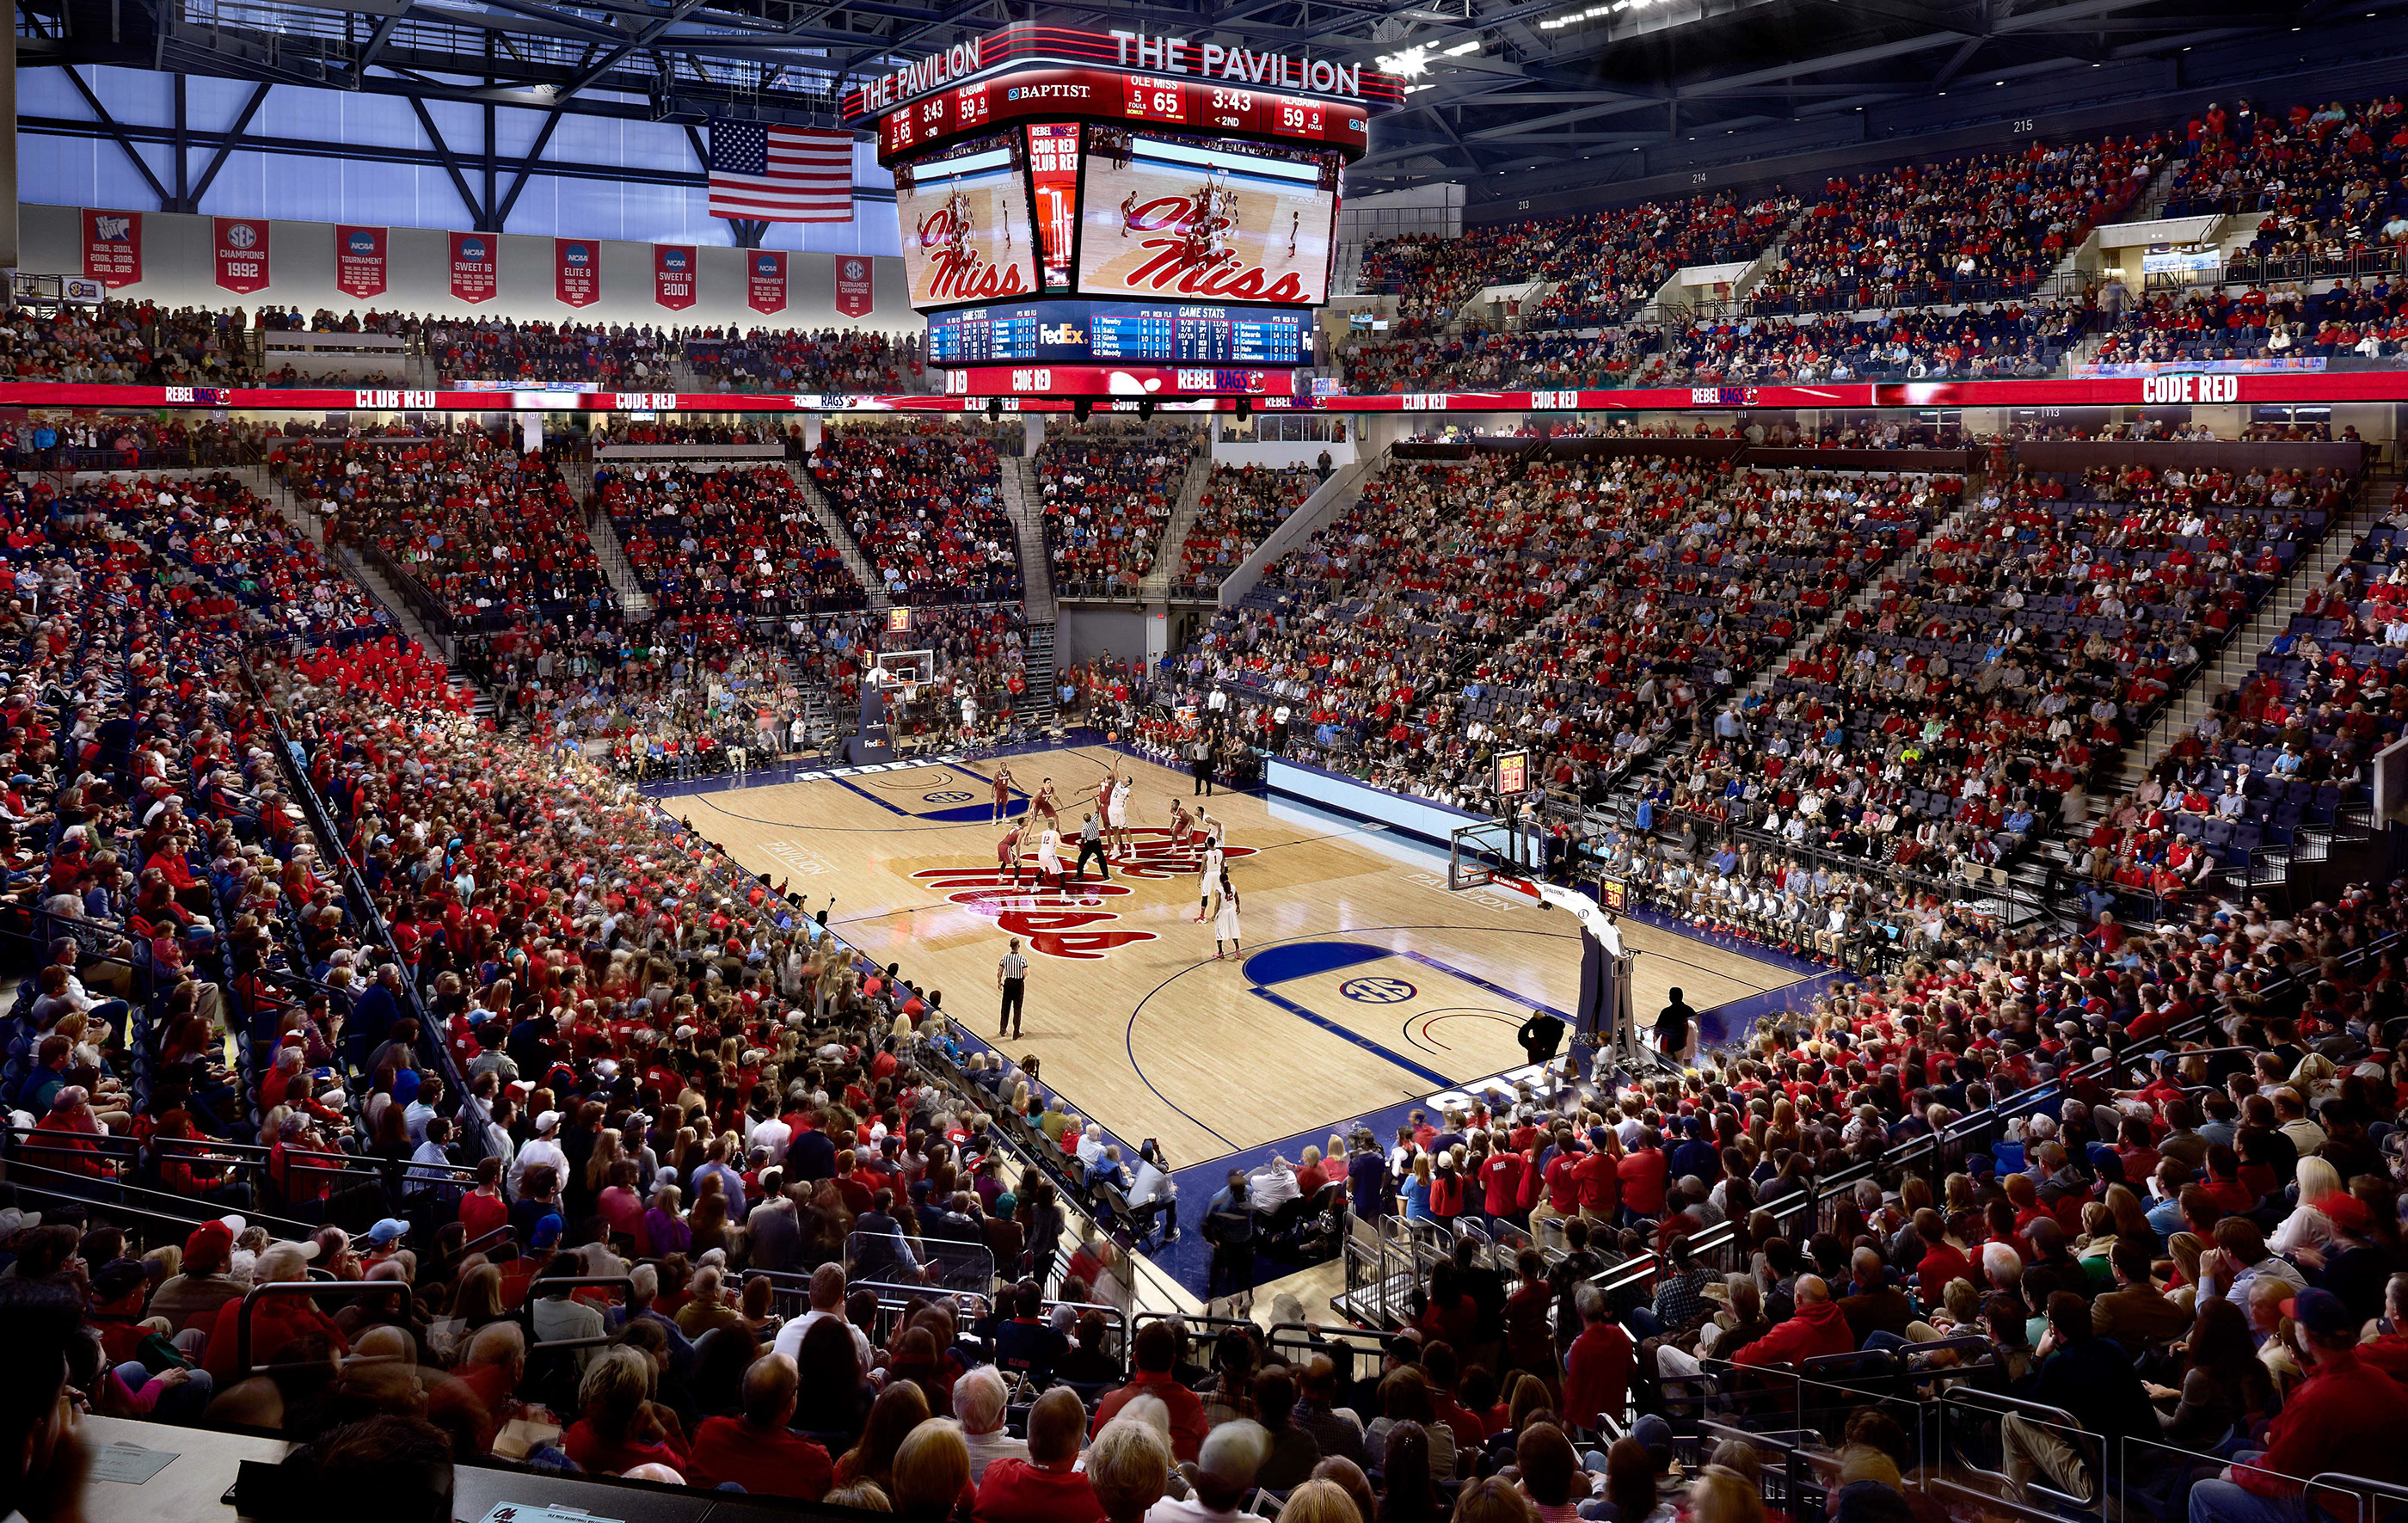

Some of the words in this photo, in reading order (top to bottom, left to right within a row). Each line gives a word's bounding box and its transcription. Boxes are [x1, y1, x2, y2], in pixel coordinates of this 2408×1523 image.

[1109, 29, 1188, 73] THE
[1202, 44, 1361, 96] PAVILION
[860, 73, 894, 113] THE
[897, 36, 982, 101] PAVILION
[959, 82, 986, 99] ALABAMA
[1131, 76, 1151, 88] OLE
[1153, 78, 1178, 90] MISS
[961, 98, 975, 120] 59
[980, 96, 985, 108] 9
[1128, 101, 1146, 110] FOULS
[1133, 90, 1141, 102] 5
[1153, 92, 1178, 113] 65
[1212, 89, 1251, 112] 3:43
[1281, 96, 1320, 109] ALABAMA
[923, 99, 943, 122] 3:43
[1283, 109, 1304, 127] 59
[1312, 113, 1319, 124] 9
[1222, 116, 1239, 127] 2ND
[2013, 119, 2033, 132] 215
[894, 126, 898, 138] 5
[900, 120, 911, 140] 65
[1032, 139, 1056, 154] CODE
[1058, 138, 1076, 153] RED
[1030, 154, 1057, 171] CLUB
[1692, 173, 1706, 183] 214
[1518, 200, 1529, 210] 213
[230, 226, 254, 247] SEC
[219, 249, 265, 260] CHAMPIONS
[341, 255, 383, 264] TOURNAMENT
[114, 265, 132, 273] 2015
[227, 262, 258, 277] 1992
[455, 261, 482, 272] SWEET
[484, 263, 492, 273] 16
[564, 267, 584, 277] ELITE
[586, 268, 591, 277] 8
[846, 261, 863, 279] SEC
[659, 272, 683, 281] SWEET
[685, 273, 692, 282] 16
[751, 276, 783, 285] TOURNAMENT
[664, 283, 688, 297] 2001
[1179, 307, 1201, 317] GAME
[1202, 308, 1225, 319] STATS
[1040, 323, 1084, 344] FedEx
[955, 370, 968, 393] RED
[1012, 369, 1033, 390] CODE
[1034, 369, 1051, 390] RED
[2143, 377, 2193, 402] CODE
[2199, 376, 2238, 402] RED
[355, 390, 399, 408] CLUB
[404, 390, 435, 408] RED
[616, 393, 648, 409] CODE
[652, 393, 677, 409] RED
[965, 397, 989, 410] CLU
[1403, 394, 1426, 410] CLUB
[1428, 394, 1447, 410] RED
[1532, 391, 1557, 409] CODE
[1558, 390, 1578, 408] RED
[2046, 408, 2060, 417] 113
[892, 617, 906, 629] 30
[864, 739, 886, 748] FedEx
[795, 756, 967, 781] REBELS
[1503, 769, 1521, 791] 30
[926, 792, 971, 802] SEC
[1042, 835, 1050, 844] 12
[765, 841, 830, 875] PAVILION
[1225, 891, 1234, 901] 42
[1408, 874, 1520, 912] PAVLION
[1544, 886, 1565, 898] SPALDING
[1607, 892, 1620, 906] 30
[1346, 980, 1411, 1002] SEC
[493, 1508, 518, 1520] Ole
